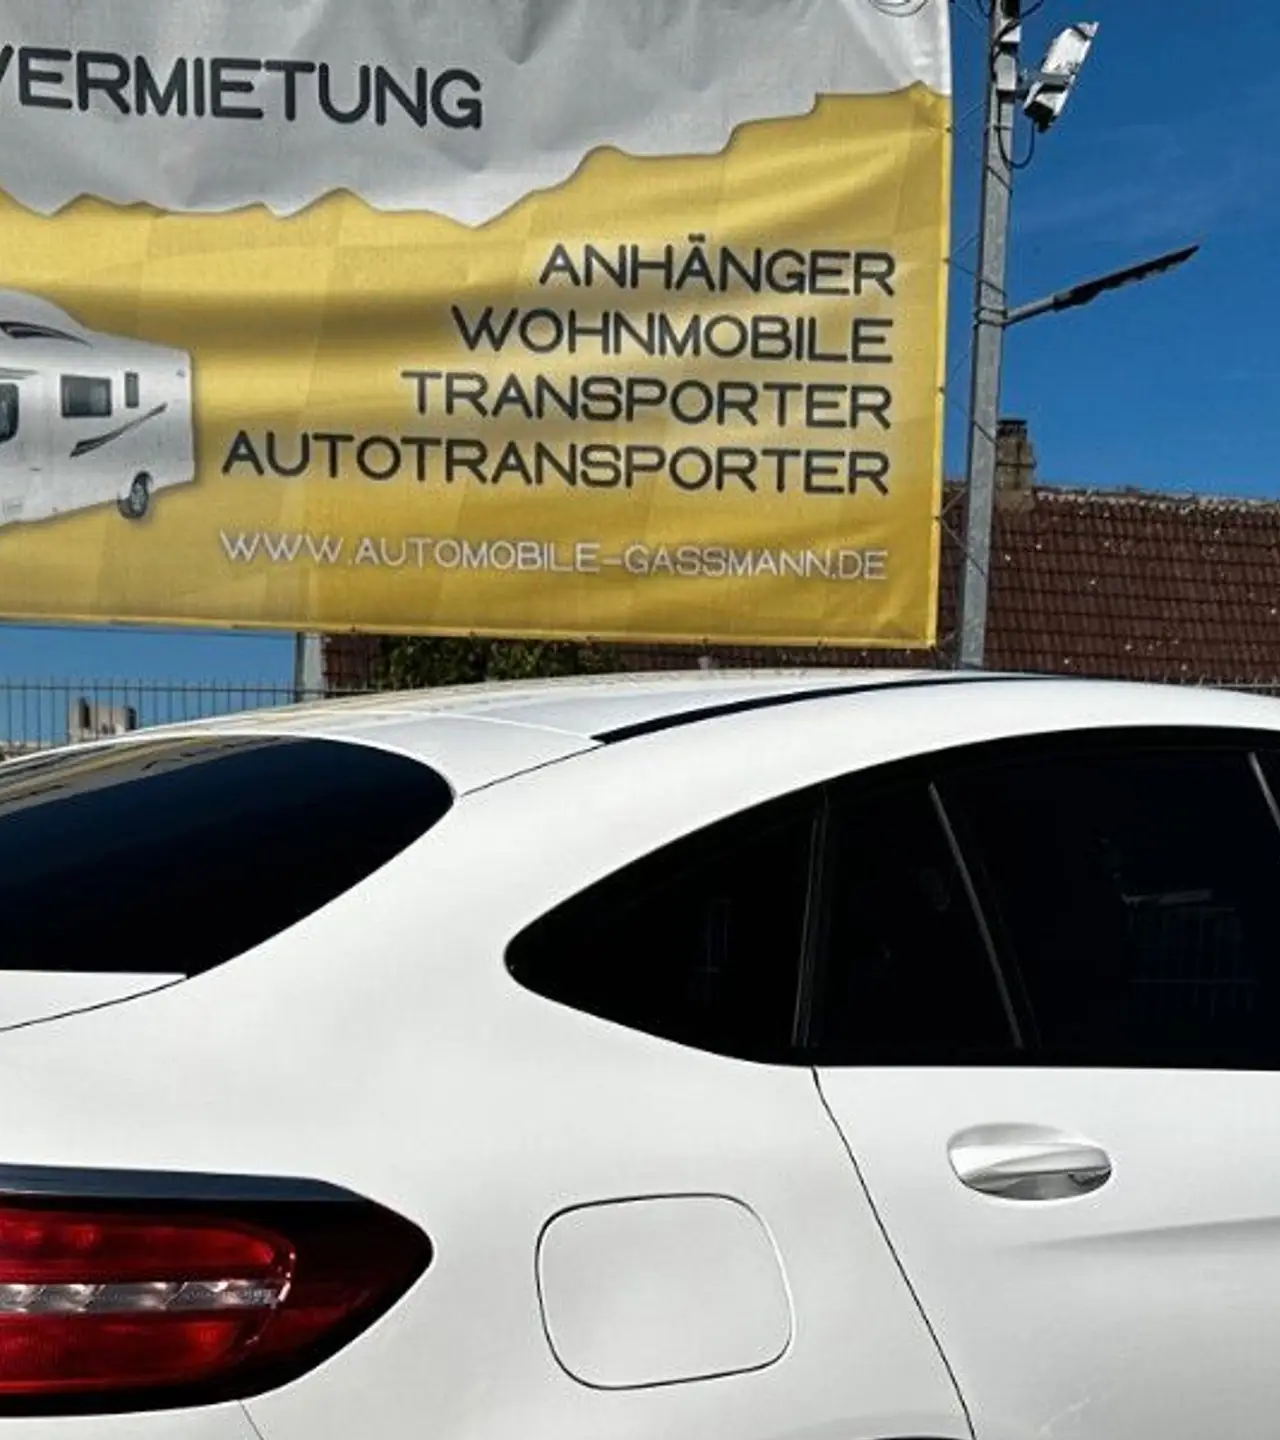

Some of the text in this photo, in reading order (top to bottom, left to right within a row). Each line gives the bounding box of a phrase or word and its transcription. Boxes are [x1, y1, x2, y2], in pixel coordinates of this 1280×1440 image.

[538, 234, 895, 296] ANHÄNGER
[452, 304, 893, 364] WOHNMOBILE
[401, 369, 892, 430] TRANSPORTER
[222, 430, 890, 495] AUTOTRANSPORTER
[220, 530, 888, 581] WWW.AUTOMOBILE-GASSMANN.DE
